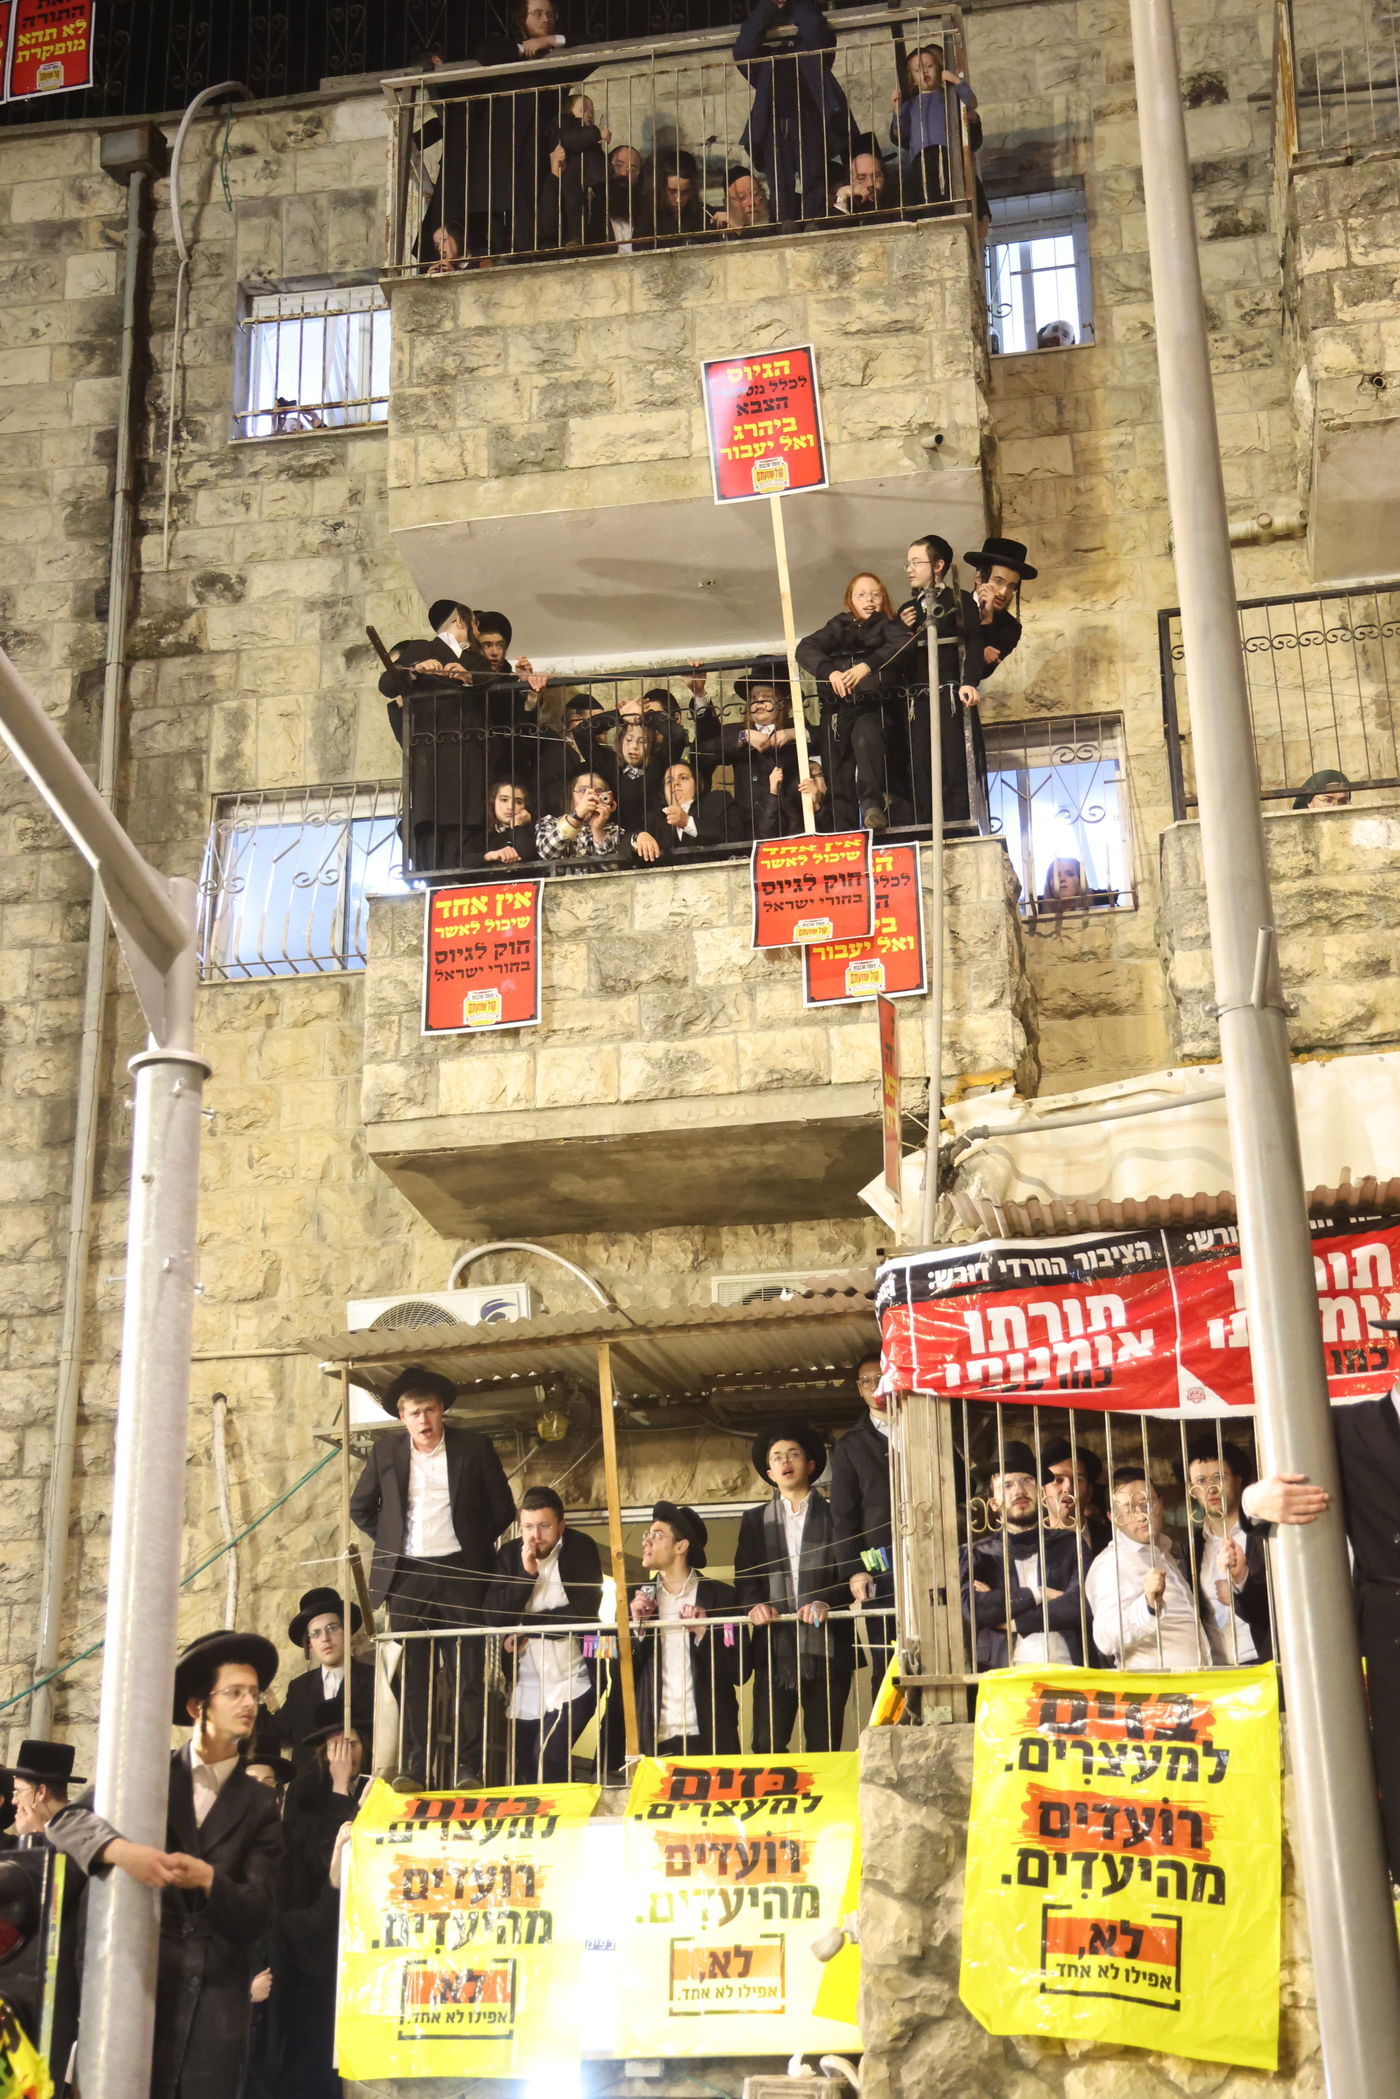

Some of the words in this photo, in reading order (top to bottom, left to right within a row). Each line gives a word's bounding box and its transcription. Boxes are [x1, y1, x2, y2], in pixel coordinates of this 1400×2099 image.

[22, 5, 85, 28] התורה
[18, 28, 57, 47] תהא
[62, 18, 87, 38] לא
[726, 360, 790, 383] הגיוס
[769, 376, 807, 393] לכלל
[736, 396, 789, 417] הצבא
[733, 417, 798, 441] ביהרג
[720, 441, 774, 460] יעבור
[779, 434, 815, 451] ואל
[825, 839, 862, 853] אין
[761, 855, 808, 870] לאשר
[812, 851, 861, 864] שיכול
[761, 873, 817, 896] לגיוס
[823, 871, 862, 894] חוק
[435, 895, 489, 919] אחד
[495, 891, 533, 917] אין
[763, 899, 815, 912] ישראל
[818, 893, 863, 906] בחורי
[434, 921, 480, 938] לאשר
[484, 916, 531, 932] שיכול
[434, 942, 488, 964] לגיוס
[494, 939, 531, 960] חוק
[812, 941, 871, 961] יעבור
[876, 936, 915, 954] ואל
[434, 967, 484, 982] ישראל
[488, 960, 530, 974] בחורי
[1186, 1225, 1240, 1253] ורש:
[1073, 1240, 1153, 1270] הציבור
[927, 1261, 992, 1290] דורש:
[998, 1256, 1068, 1279] החרדי
[963, 1293, 1127, 1355] תורתו
[942, 1328, 1155, 1388] אומנותו
[1331, 1347, 1389, 1375] כמו
[412, 1796, 542, 1819] בזים
[1078, 1919, 1144, 1960] לא,
[699, 1944, 754, 1984] לא,
[1098, 1963, 1120, 1980] לא
[1125, 1966, 1172, 1990] אפילו
[715, 1984, 733, 1998] לא
[738, 1984, 778, 1998] אפילו
[446, 2009, 464, 2024] לא
